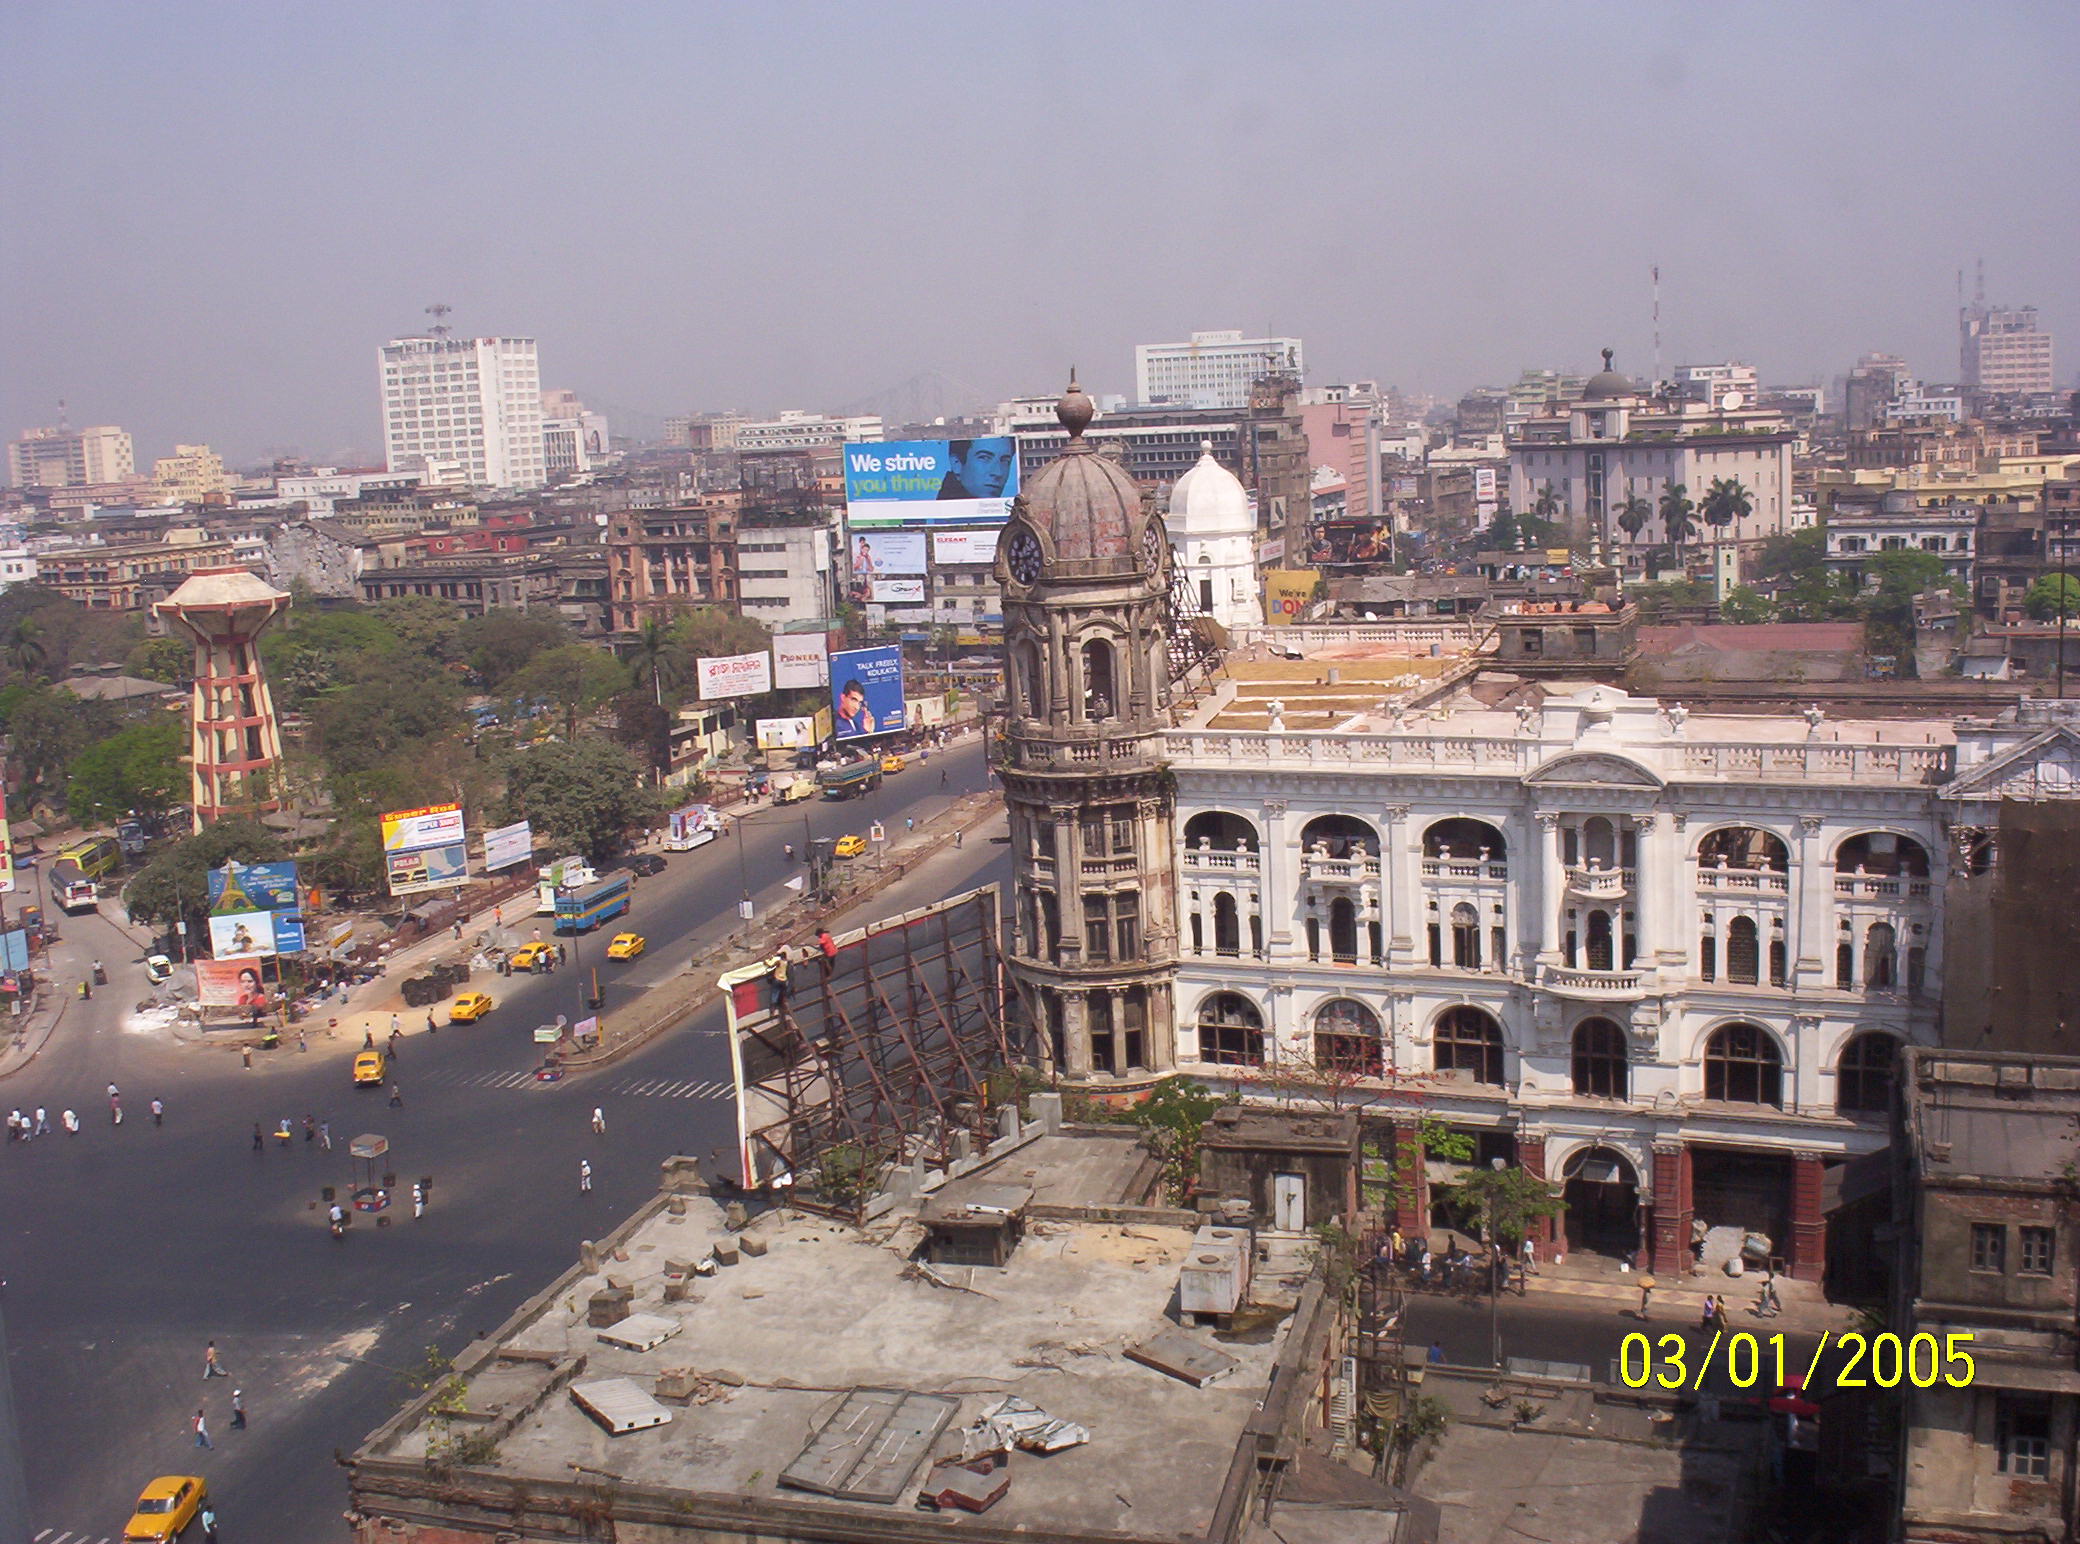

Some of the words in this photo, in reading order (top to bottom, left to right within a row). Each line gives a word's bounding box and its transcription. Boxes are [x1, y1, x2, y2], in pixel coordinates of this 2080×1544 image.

[851, 454, 881, 472] We
[885, 452, 936, 472] strive
[852, 479, 888, 497] you
[891, 473, 942, 492] thrive
[856, 662, 874, 670] TALK
